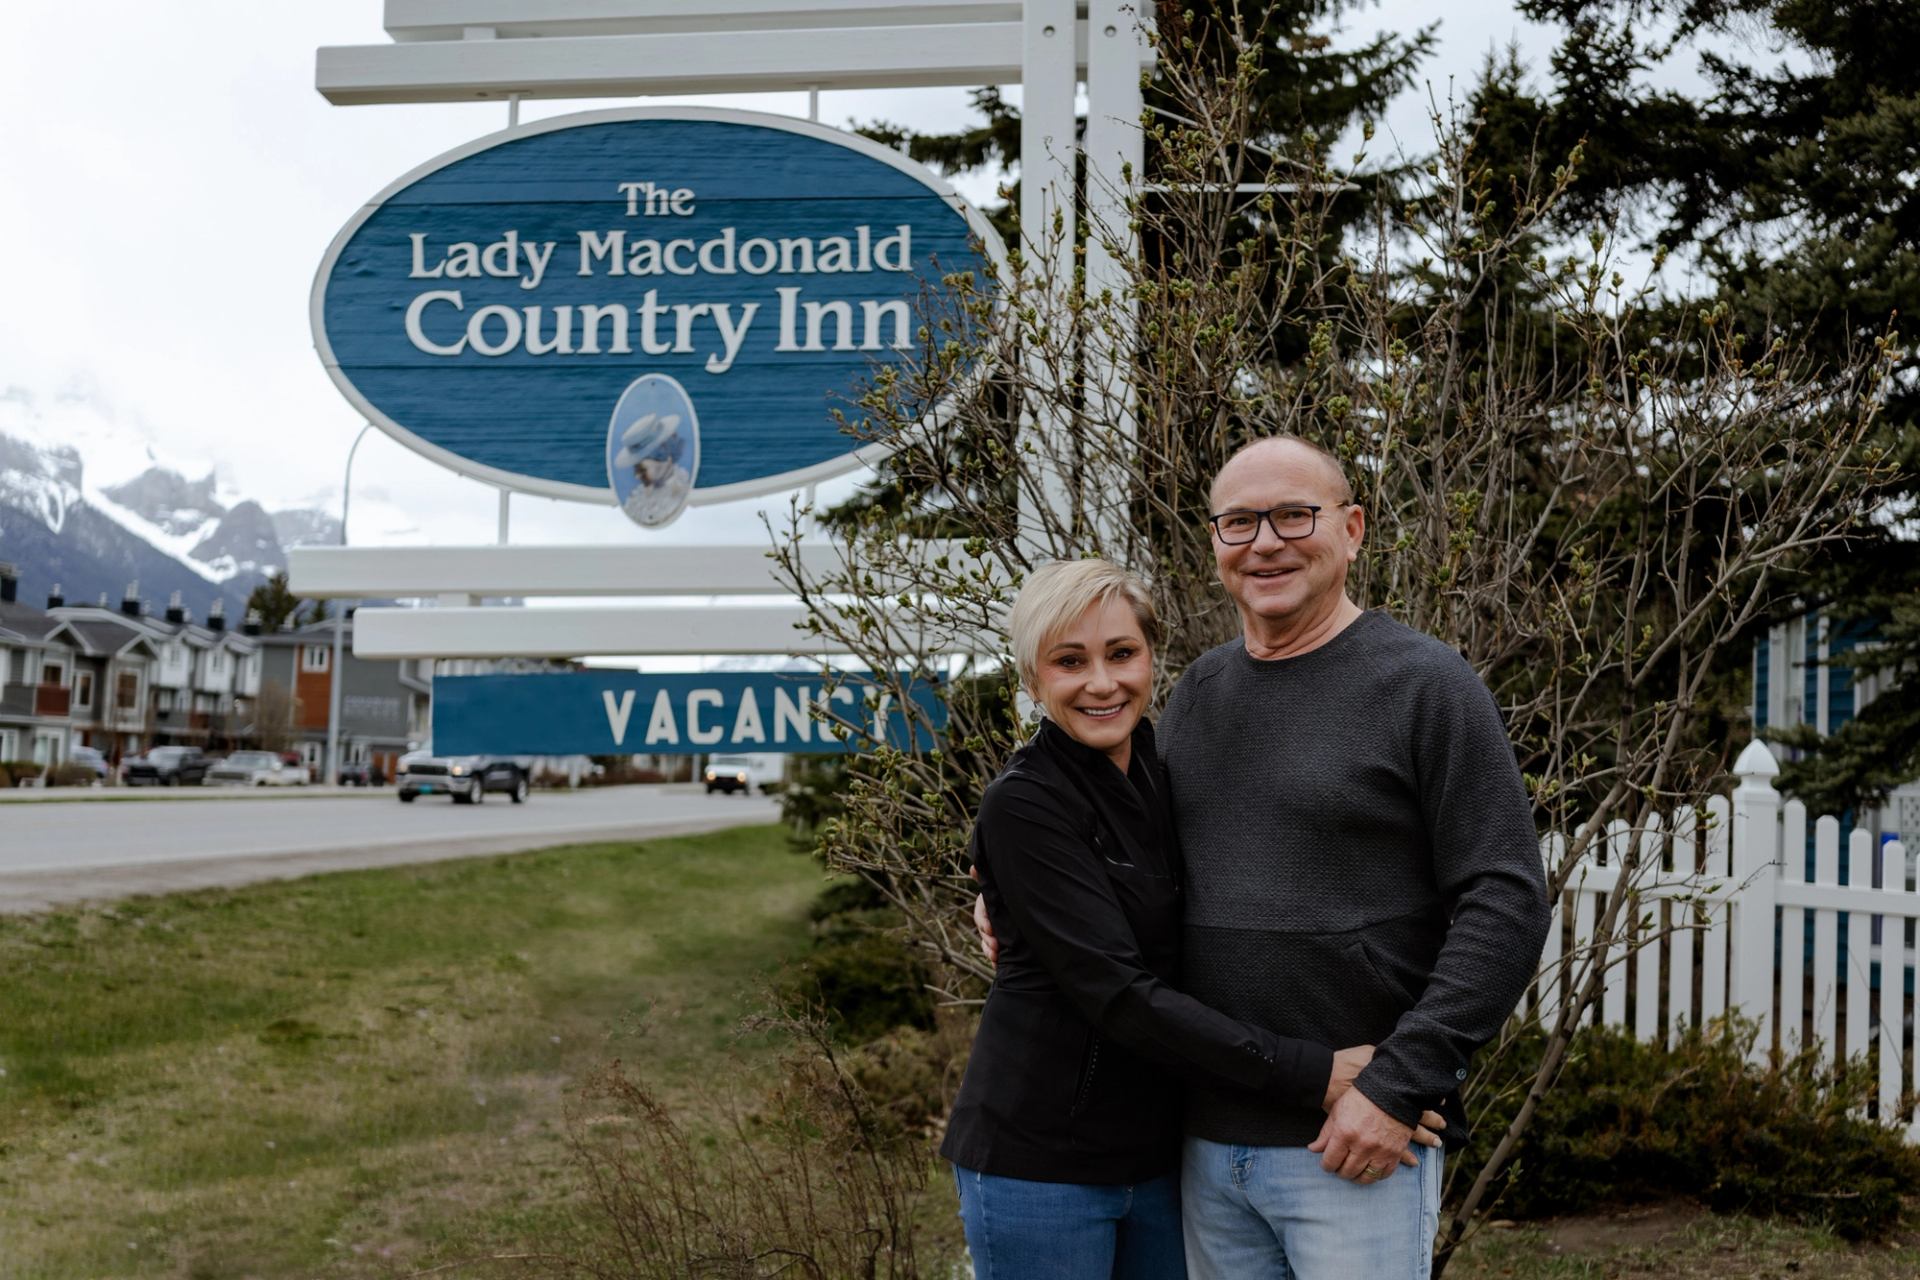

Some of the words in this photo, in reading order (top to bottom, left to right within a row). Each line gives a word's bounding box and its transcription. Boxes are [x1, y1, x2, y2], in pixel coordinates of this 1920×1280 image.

[617, 182, 695, 216] The
[408, 230, 556, 290] Lady
[577, 225, 913, 276] Macdonald
[404, 289, 760, 373] Country
[774, 287, 915, 352] Inn
